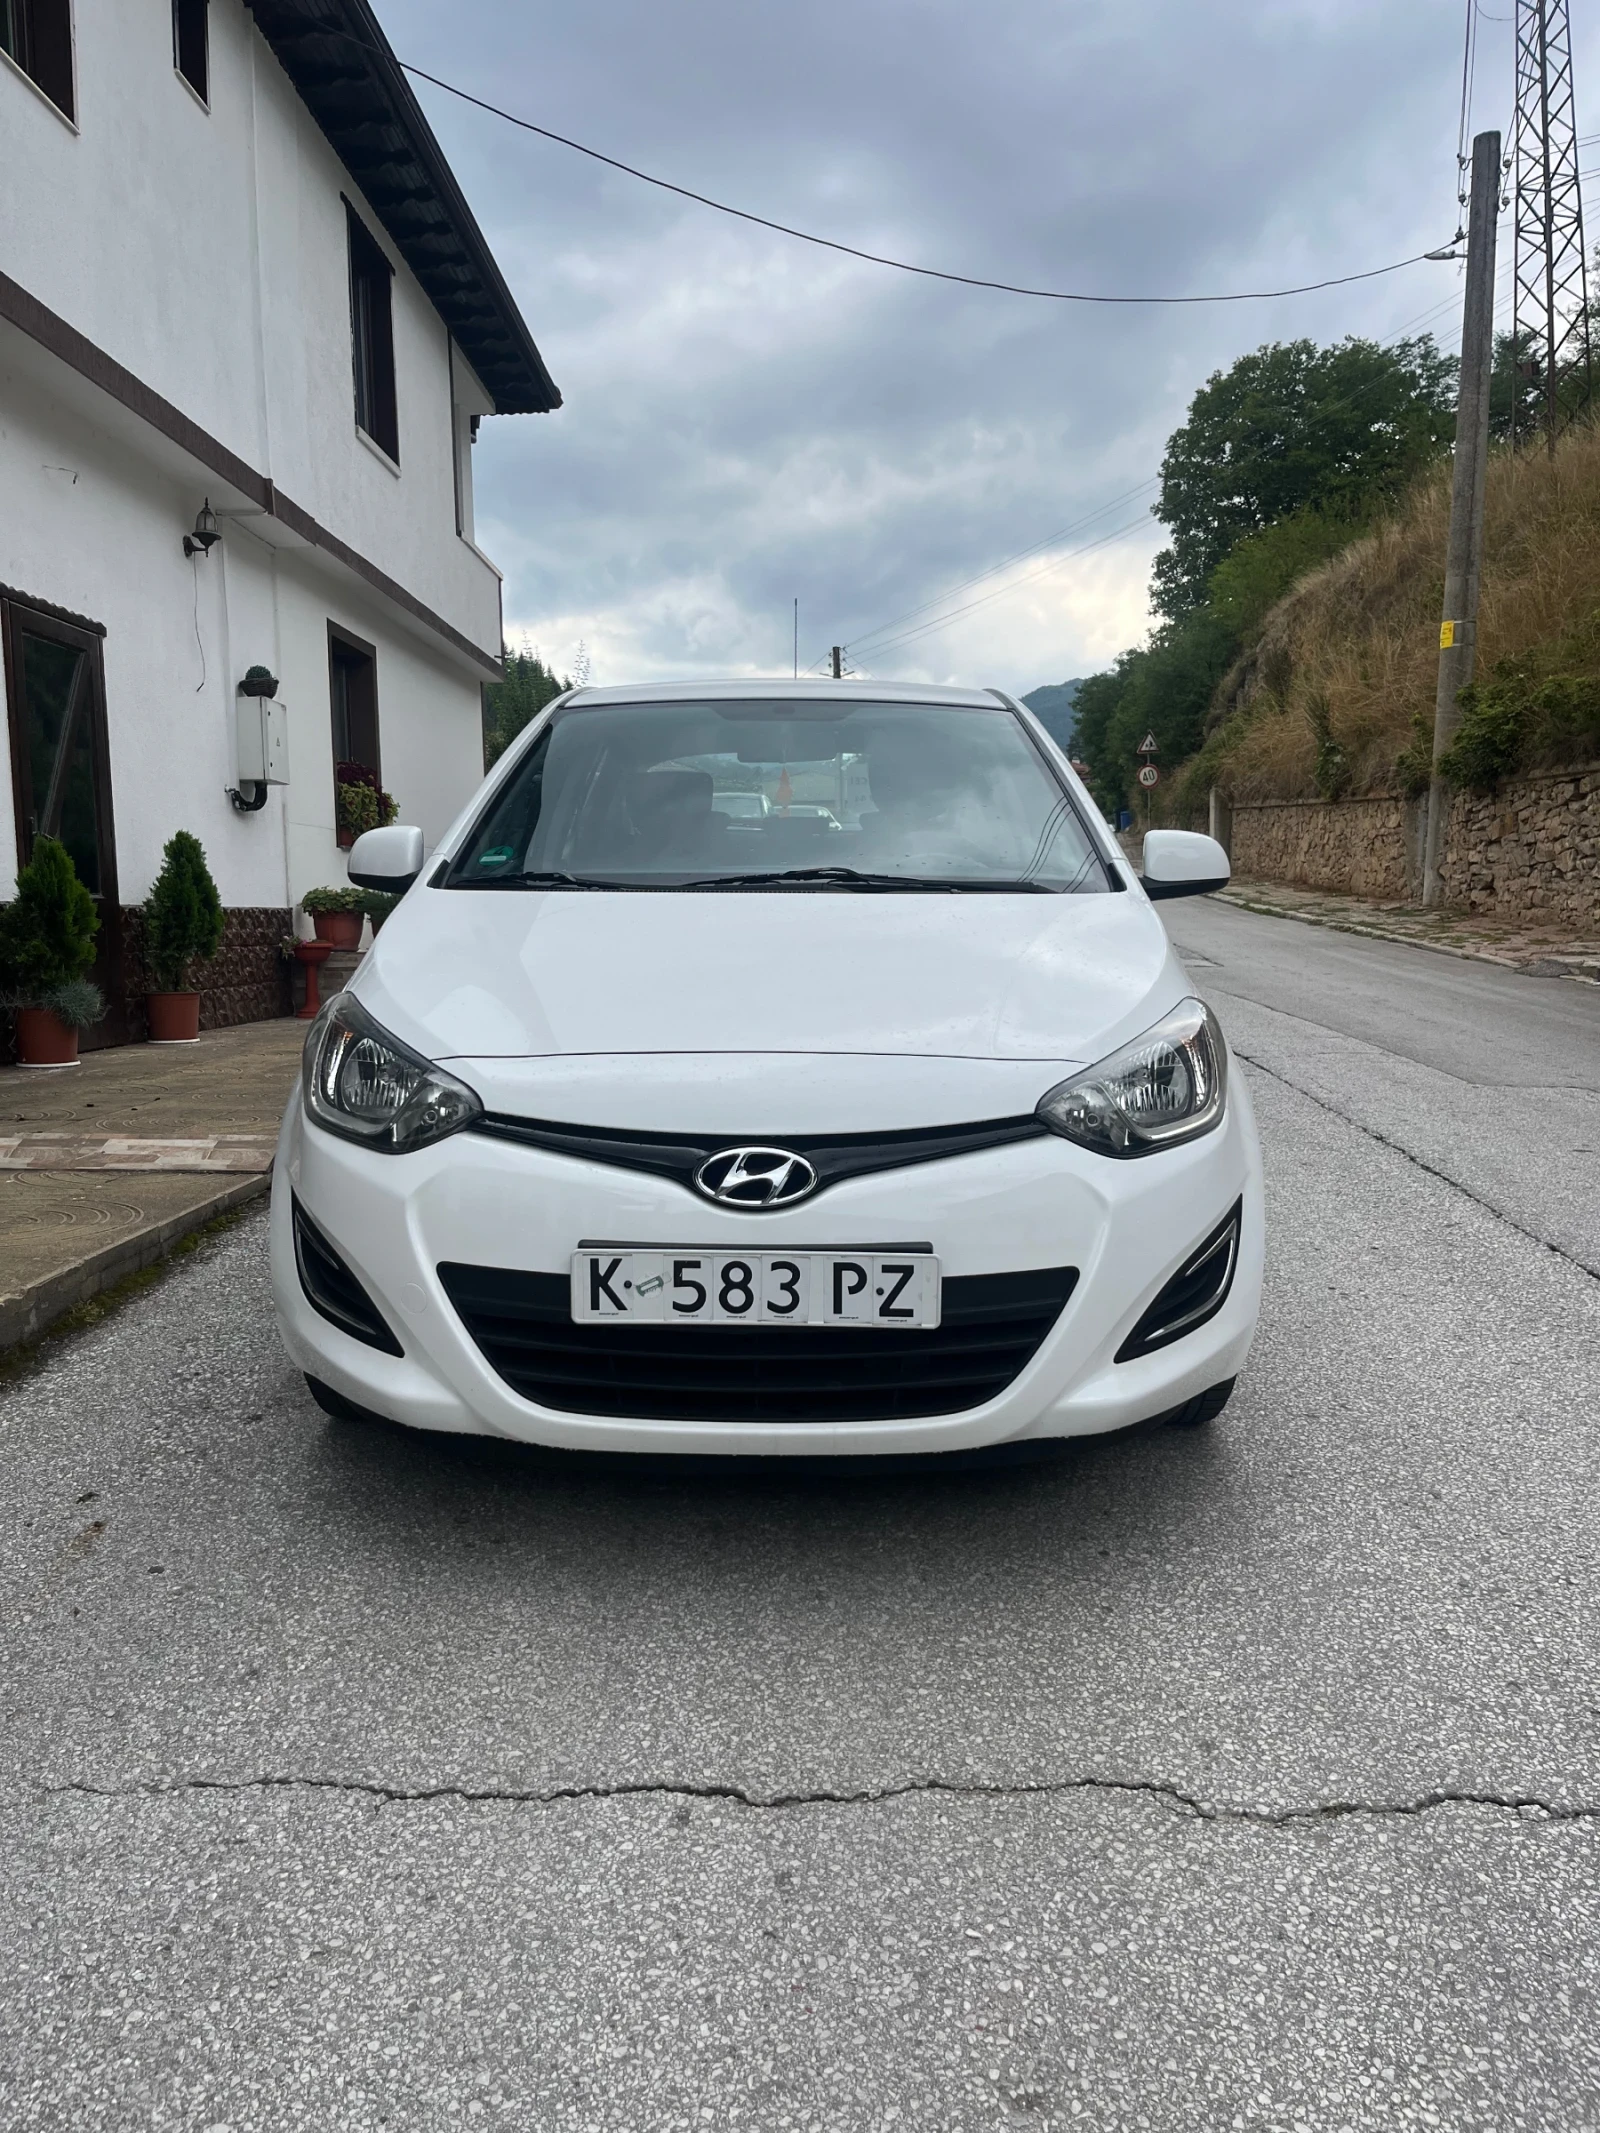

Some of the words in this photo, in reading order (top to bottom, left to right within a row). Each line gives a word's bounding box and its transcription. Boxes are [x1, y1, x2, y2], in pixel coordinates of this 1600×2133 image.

[1142, 769, 1156, 782] 40
[590, 1258, 628, 1311] K
[672, 1260, 800, 1314] 583
